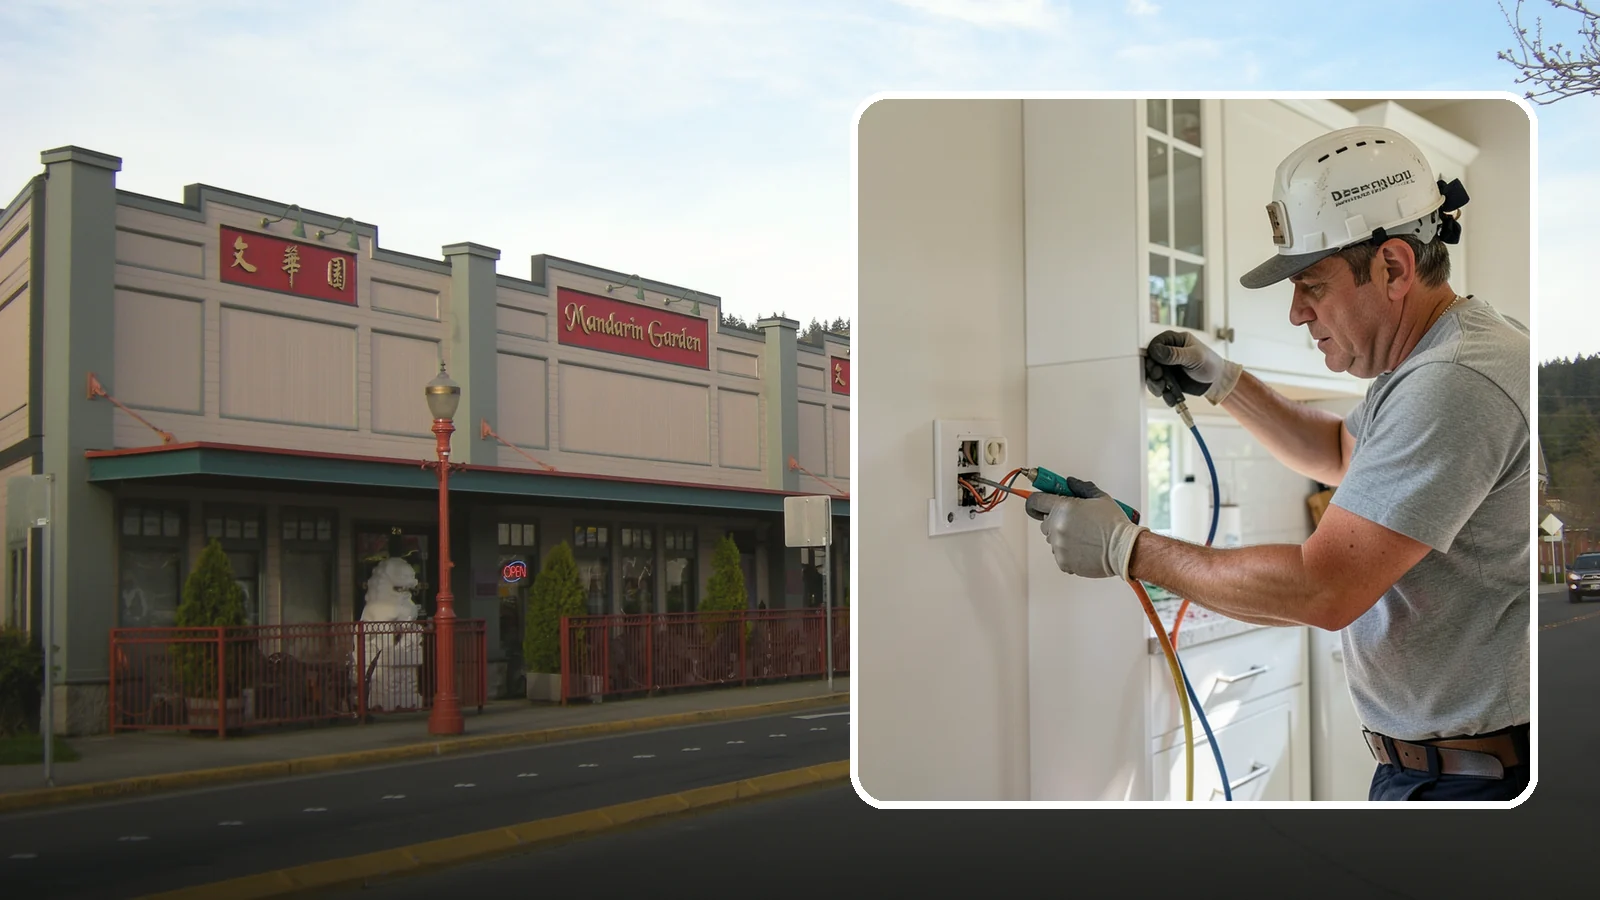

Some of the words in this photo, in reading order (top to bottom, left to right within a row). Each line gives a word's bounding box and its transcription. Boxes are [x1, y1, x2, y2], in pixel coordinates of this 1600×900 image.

[231, 235, 346, 290] 文華園
[564, 302, 644, 341] Mandarin
[648, 320, 702, 352] Garden
[503, 565, 527, 579] OPEN
